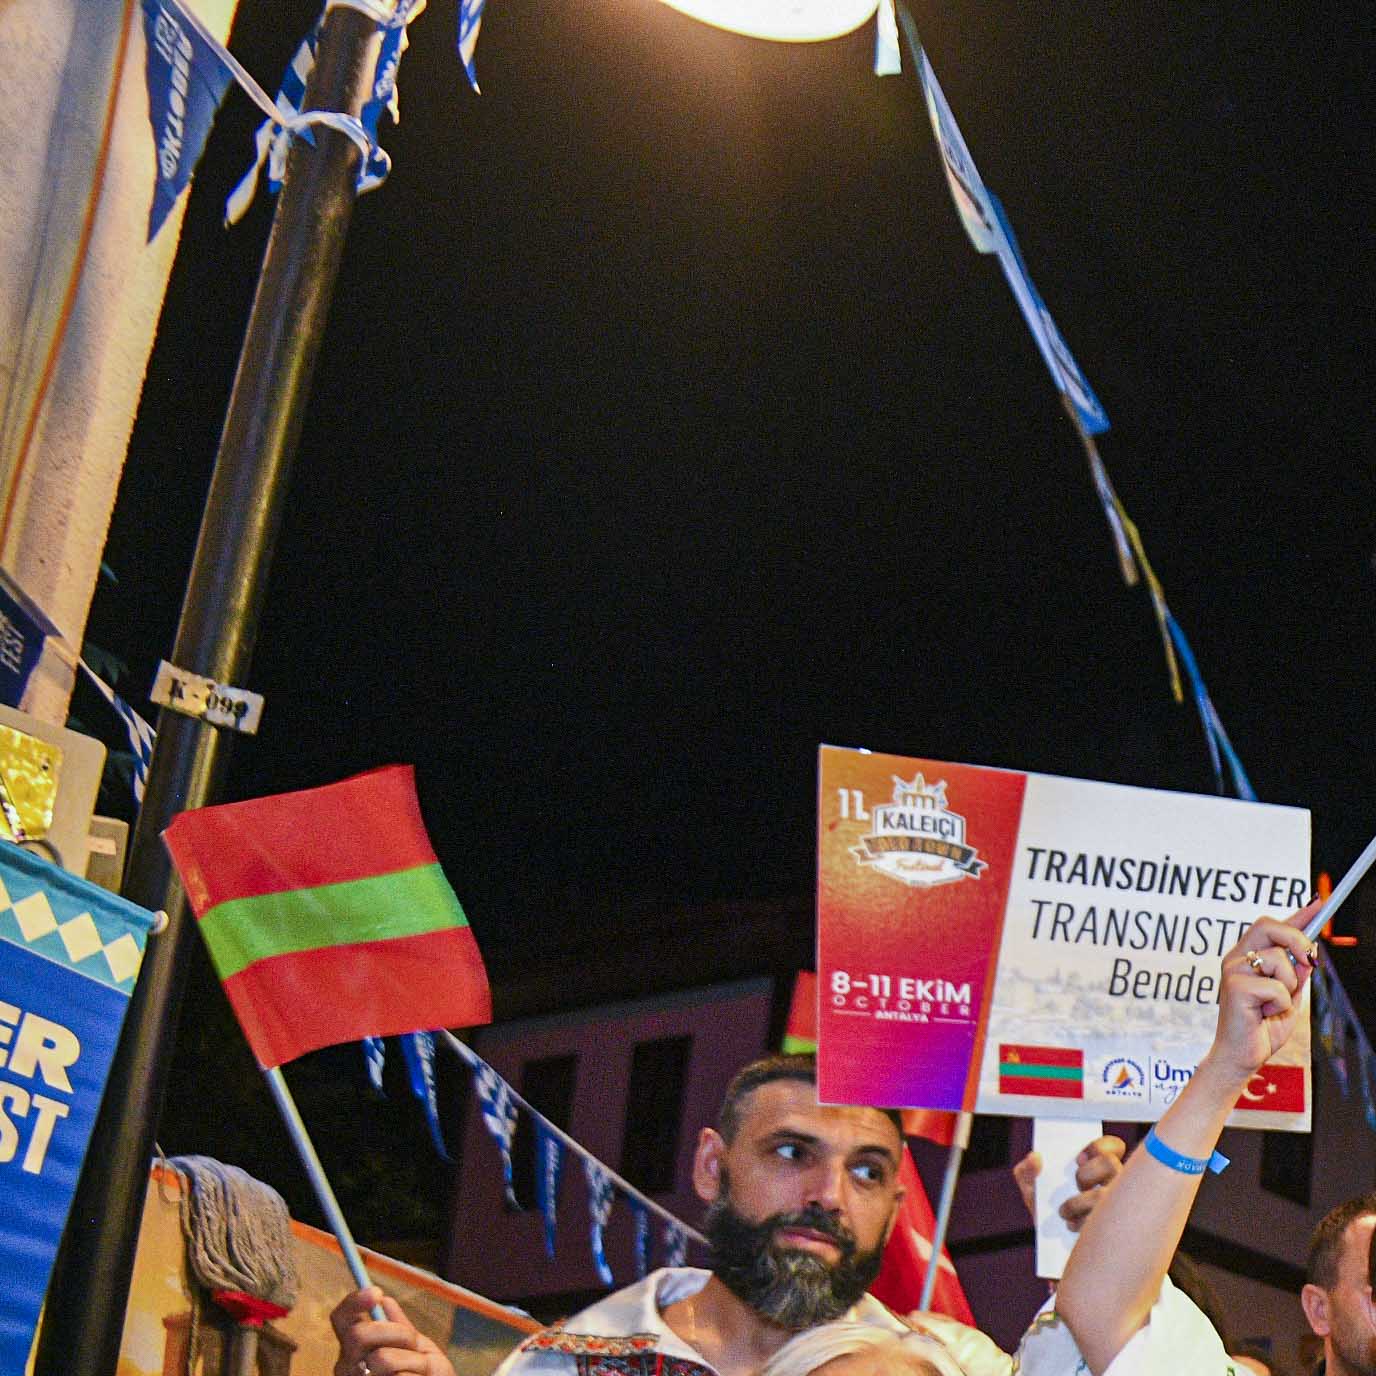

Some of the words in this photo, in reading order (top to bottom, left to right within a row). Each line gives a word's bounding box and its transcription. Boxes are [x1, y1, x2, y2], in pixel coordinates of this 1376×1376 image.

[1027, 848, 1307, 908] TRANSDİNYESTER
[1030, 899, 1252, 957] TRANSNIST
[831, 971, 891, 998] 8-11
[900, 978, 971, 1004] EKİM
[1108, 958, 1218, 1005] Bende
[832, 995, 970, 1017] OCTOBER
